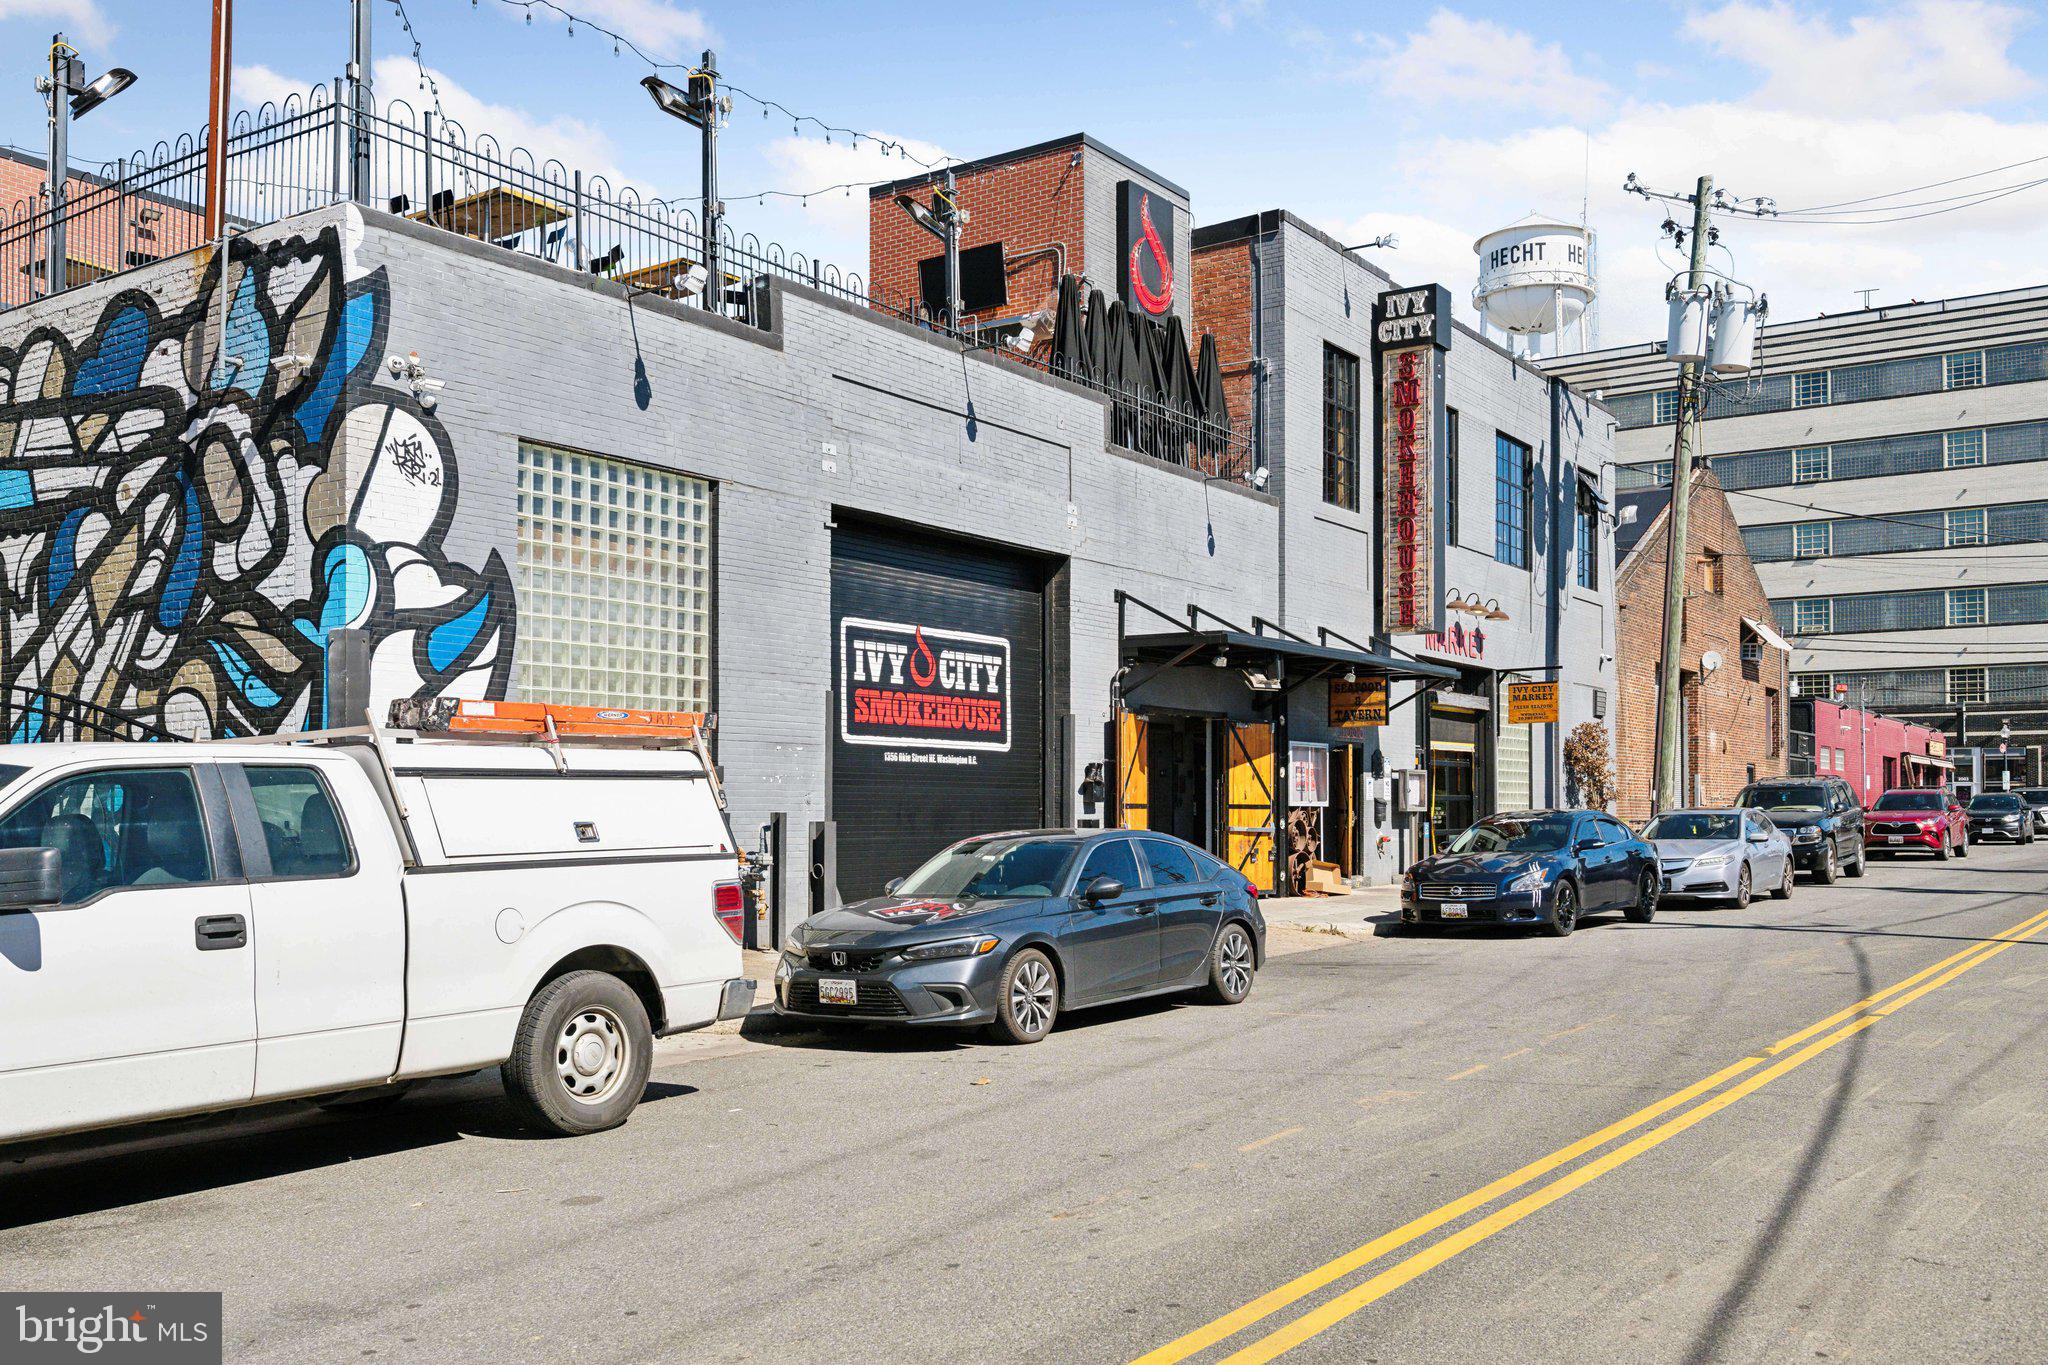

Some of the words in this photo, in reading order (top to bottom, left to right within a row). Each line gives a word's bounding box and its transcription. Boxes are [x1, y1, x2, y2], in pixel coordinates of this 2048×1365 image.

[1491, 242, 1546, 269] HECHT
[1386, 290, 1429, 318] IVY
[1378, 314, 1435, 343] CITY
[1393, 351, 1421, 626] SMOKEHOUSE
[1425, 625, 1488, 660] MARKET
[853, 639, 908, 684] IVY
[939, 649, 1002, 693] CITY
[1335, 681, 1382, 693] SEAFOOD
[1513, 693, 1553, 701] MARKET
[854, 687, 1002, 732] SMOKEHOUSE
[1335, 708, 1382, 723] TAVERN
[884, 752, 898, 761] 1356
[898, 752, 912, 763] Okie
[911, 752, 928, 763] Street
[937, 754, 968, 765] Washington
